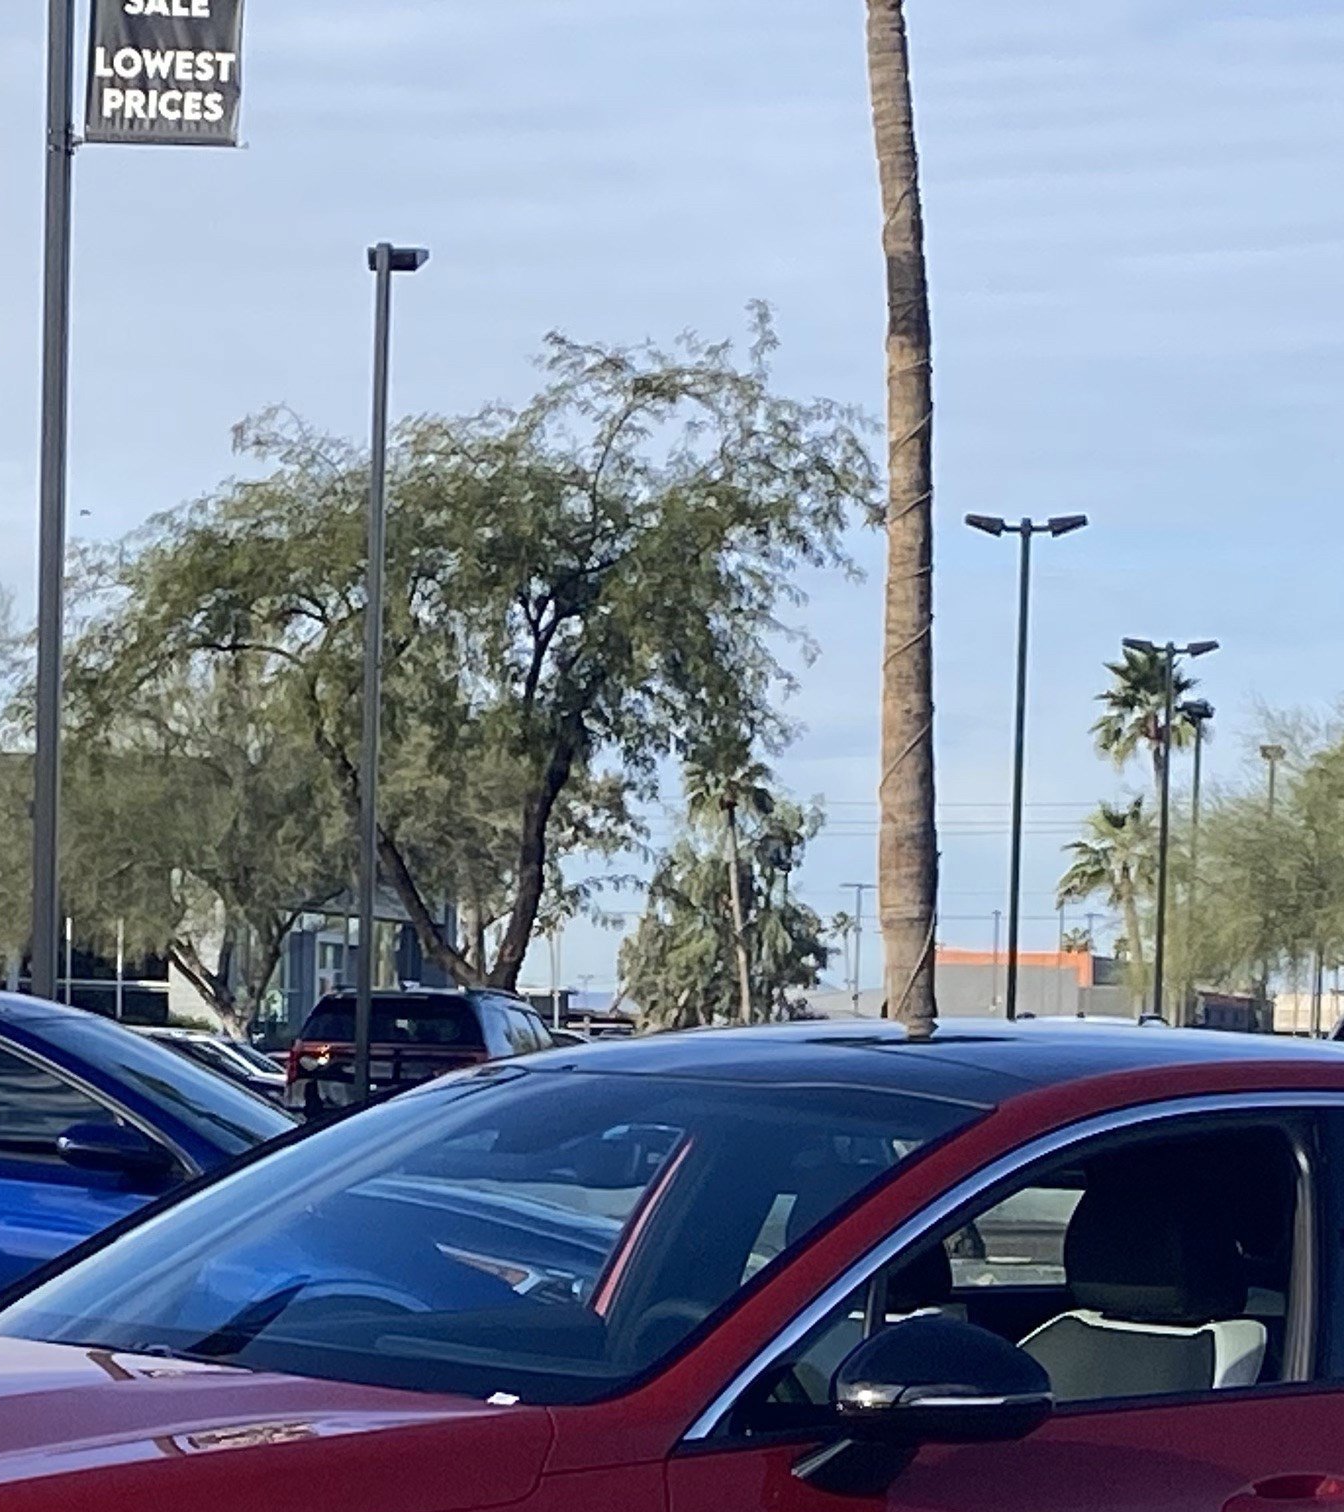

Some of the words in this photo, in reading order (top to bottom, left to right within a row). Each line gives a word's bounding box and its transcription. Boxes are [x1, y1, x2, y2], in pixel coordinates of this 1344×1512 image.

[124, 0, 211, 18] SALE
[95, 47, 236, 83] LOWEST
[102, 88, 225, 122] PRICES
